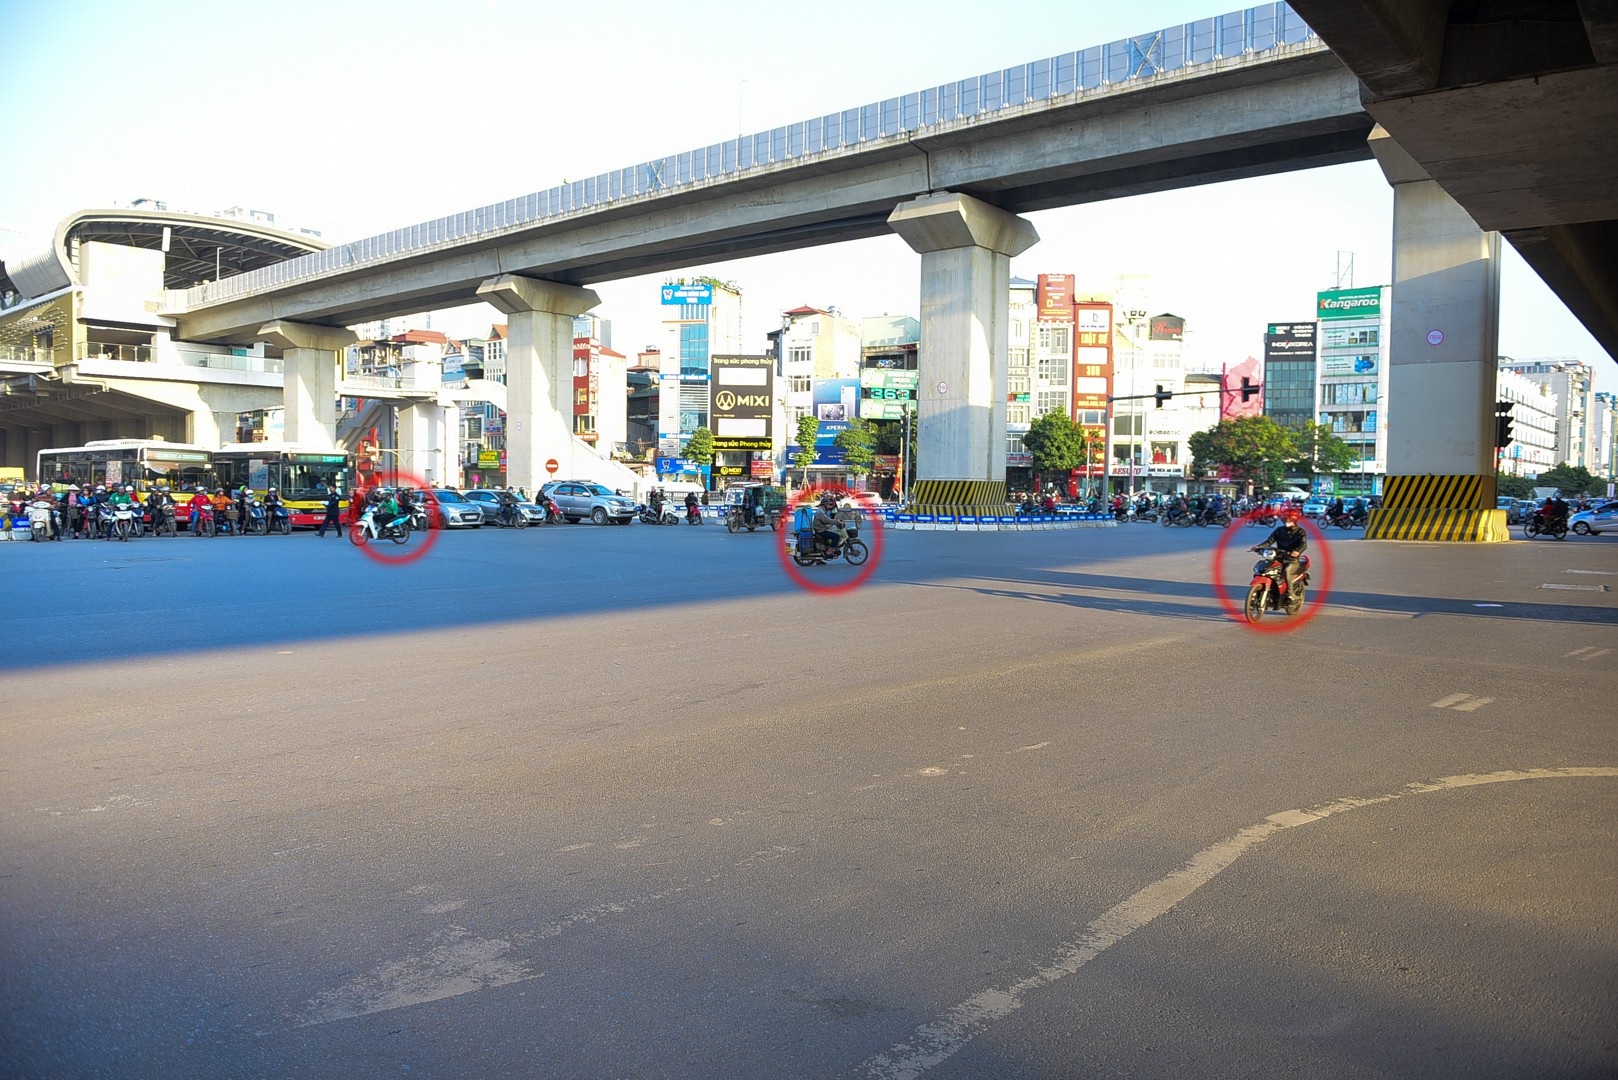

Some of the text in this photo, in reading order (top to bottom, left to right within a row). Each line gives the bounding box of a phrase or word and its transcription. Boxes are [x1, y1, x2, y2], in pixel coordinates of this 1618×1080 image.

[1320, 298, 1379, 310] Kangaroo
[737, 395, 770, 407] MIXI
[788, 452, 821, 460] SY
